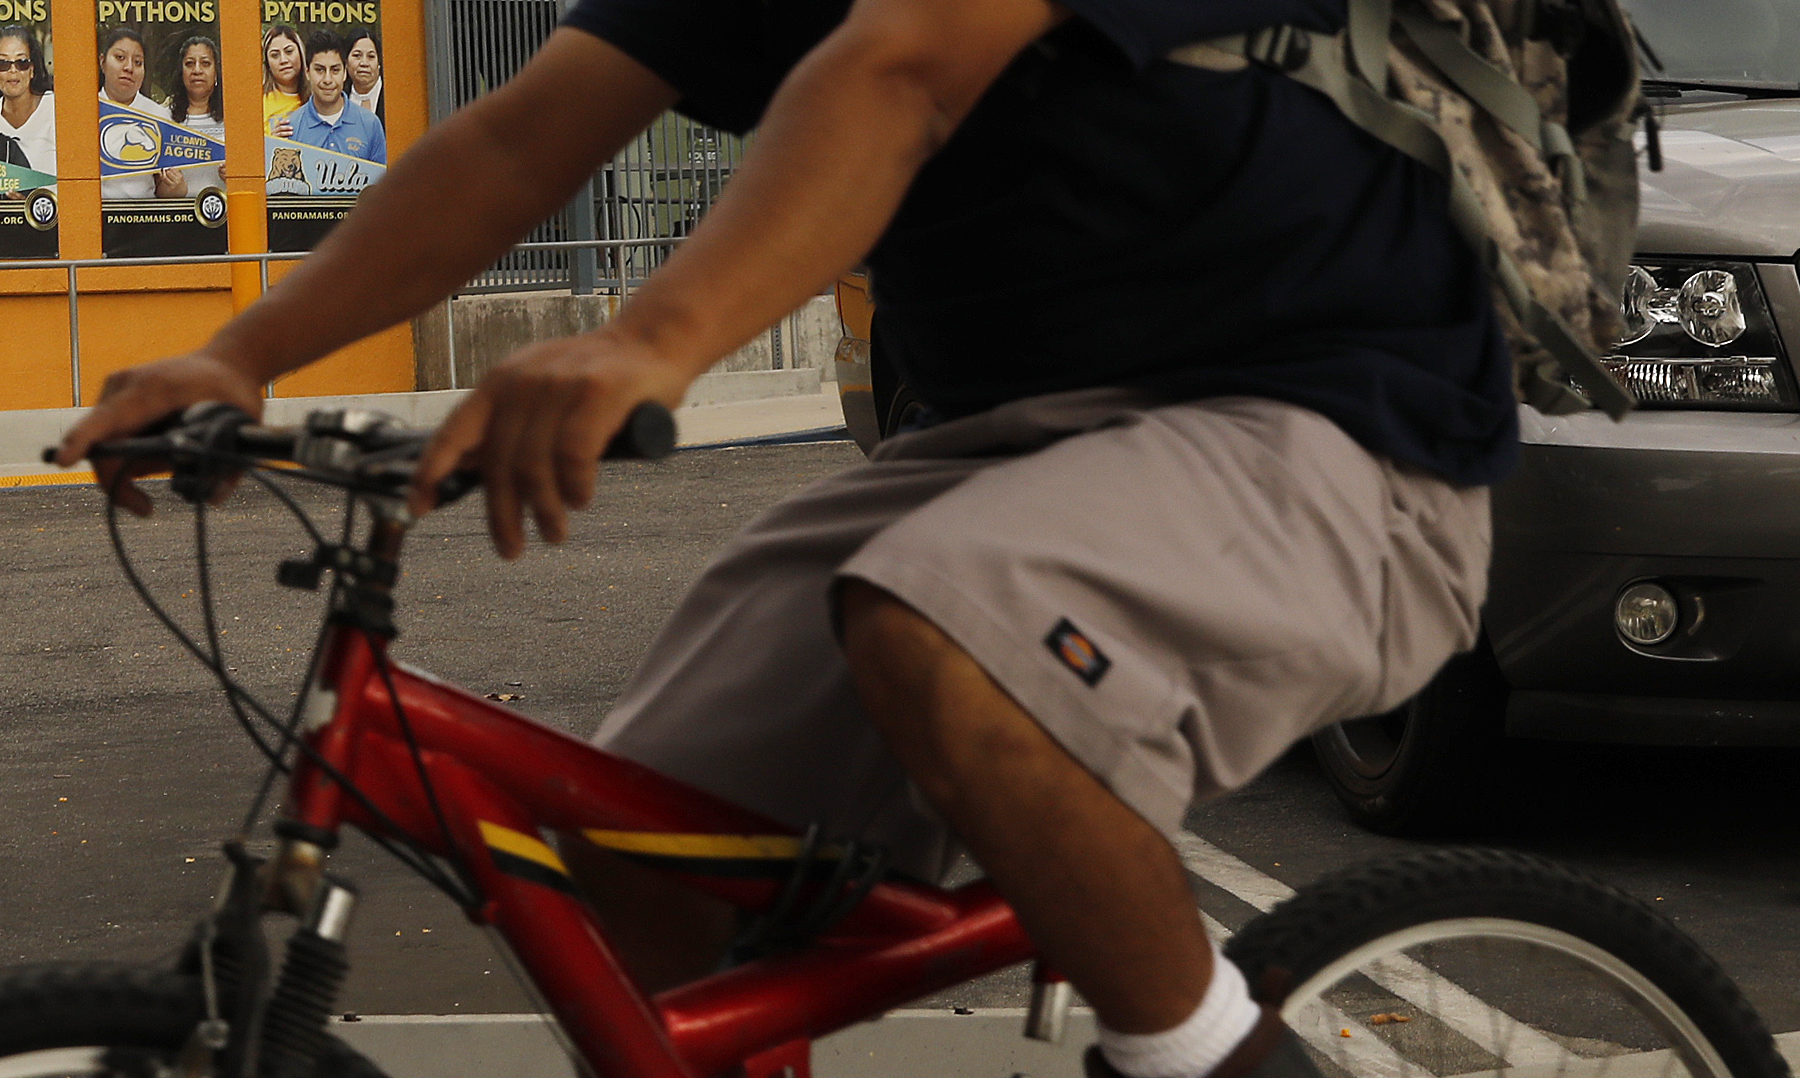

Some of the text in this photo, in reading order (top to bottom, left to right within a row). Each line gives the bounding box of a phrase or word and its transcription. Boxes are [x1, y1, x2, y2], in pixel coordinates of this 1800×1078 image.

[99, 1, 215, 22] PYTHONS
[264, 1, 377, 23] PYTHONS
[164, 145, 212, 161] AGGIES
[107, 214, 194, 224] PANORAMAHS.ORG
[272, 212, 349, 220] PANORAMAHS.OR
